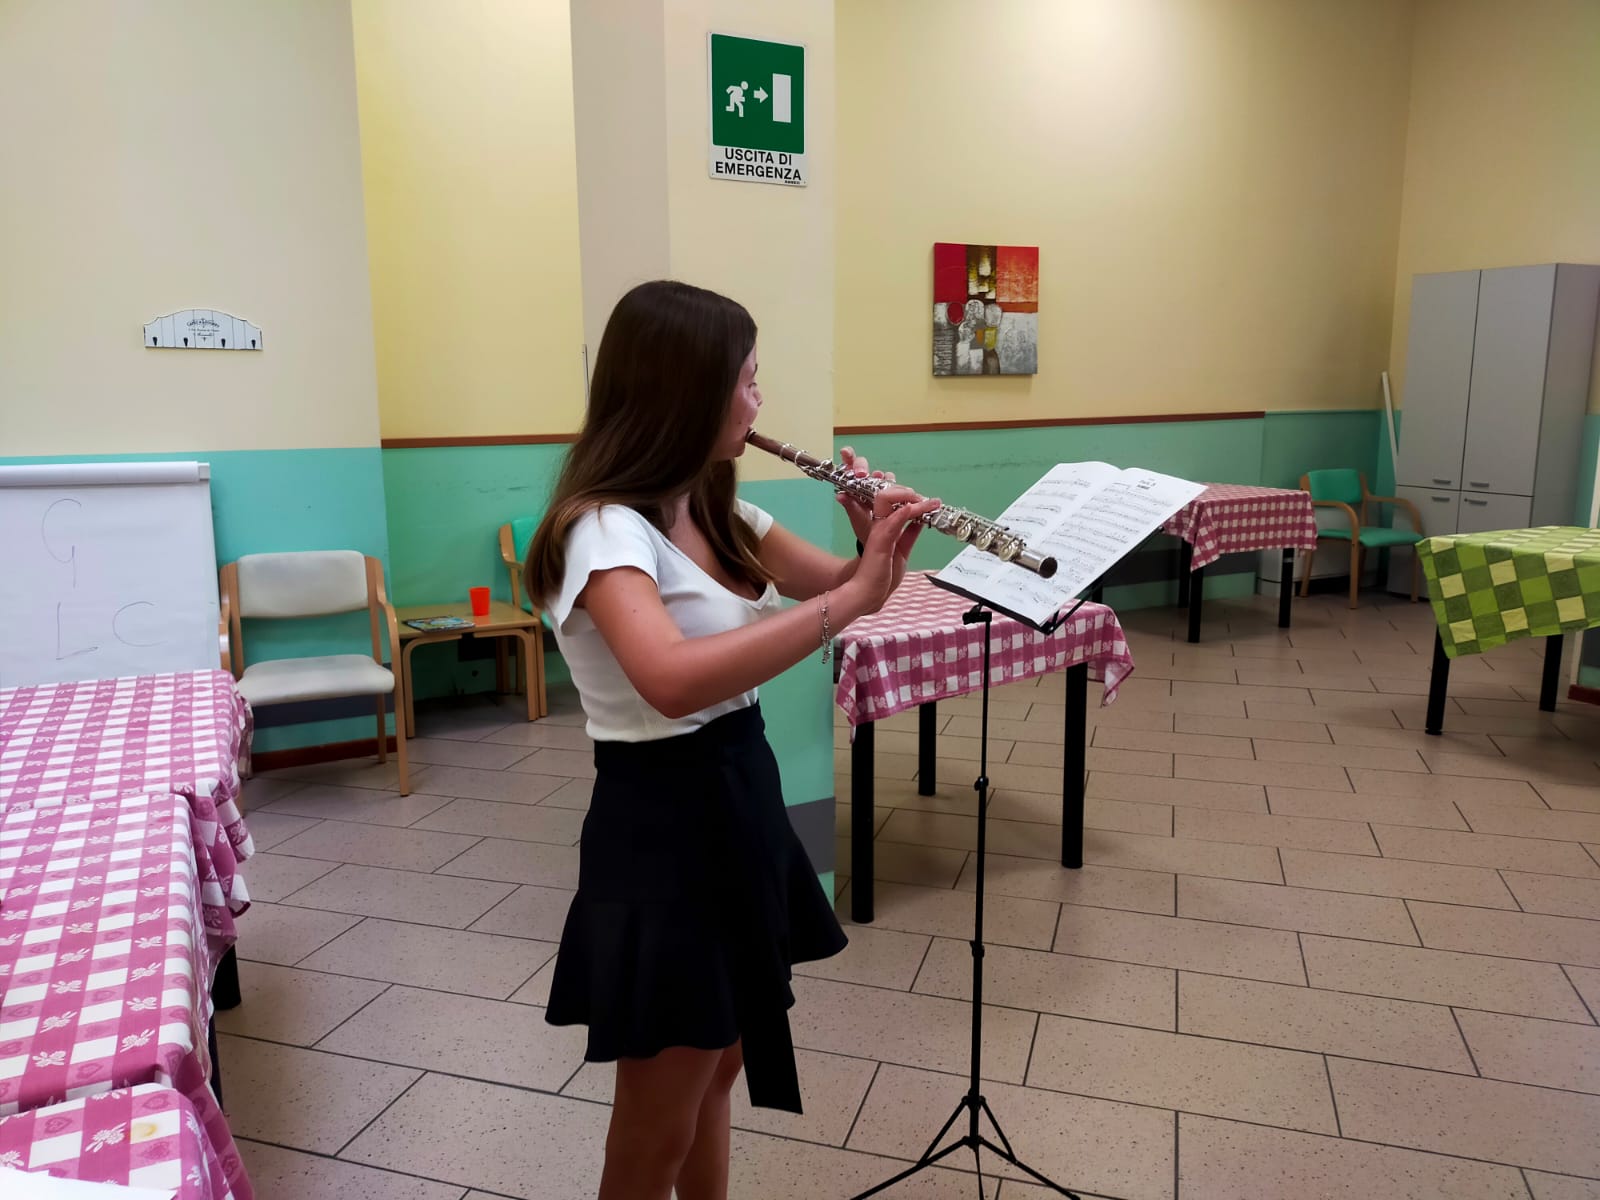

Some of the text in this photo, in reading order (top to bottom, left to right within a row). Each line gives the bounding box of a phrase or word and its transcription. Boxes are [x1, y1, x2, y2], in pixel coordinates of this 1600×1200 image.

[725, 147, 792, 166] USCITA DI
[715, 161, 802, 181] EMERGENZA
